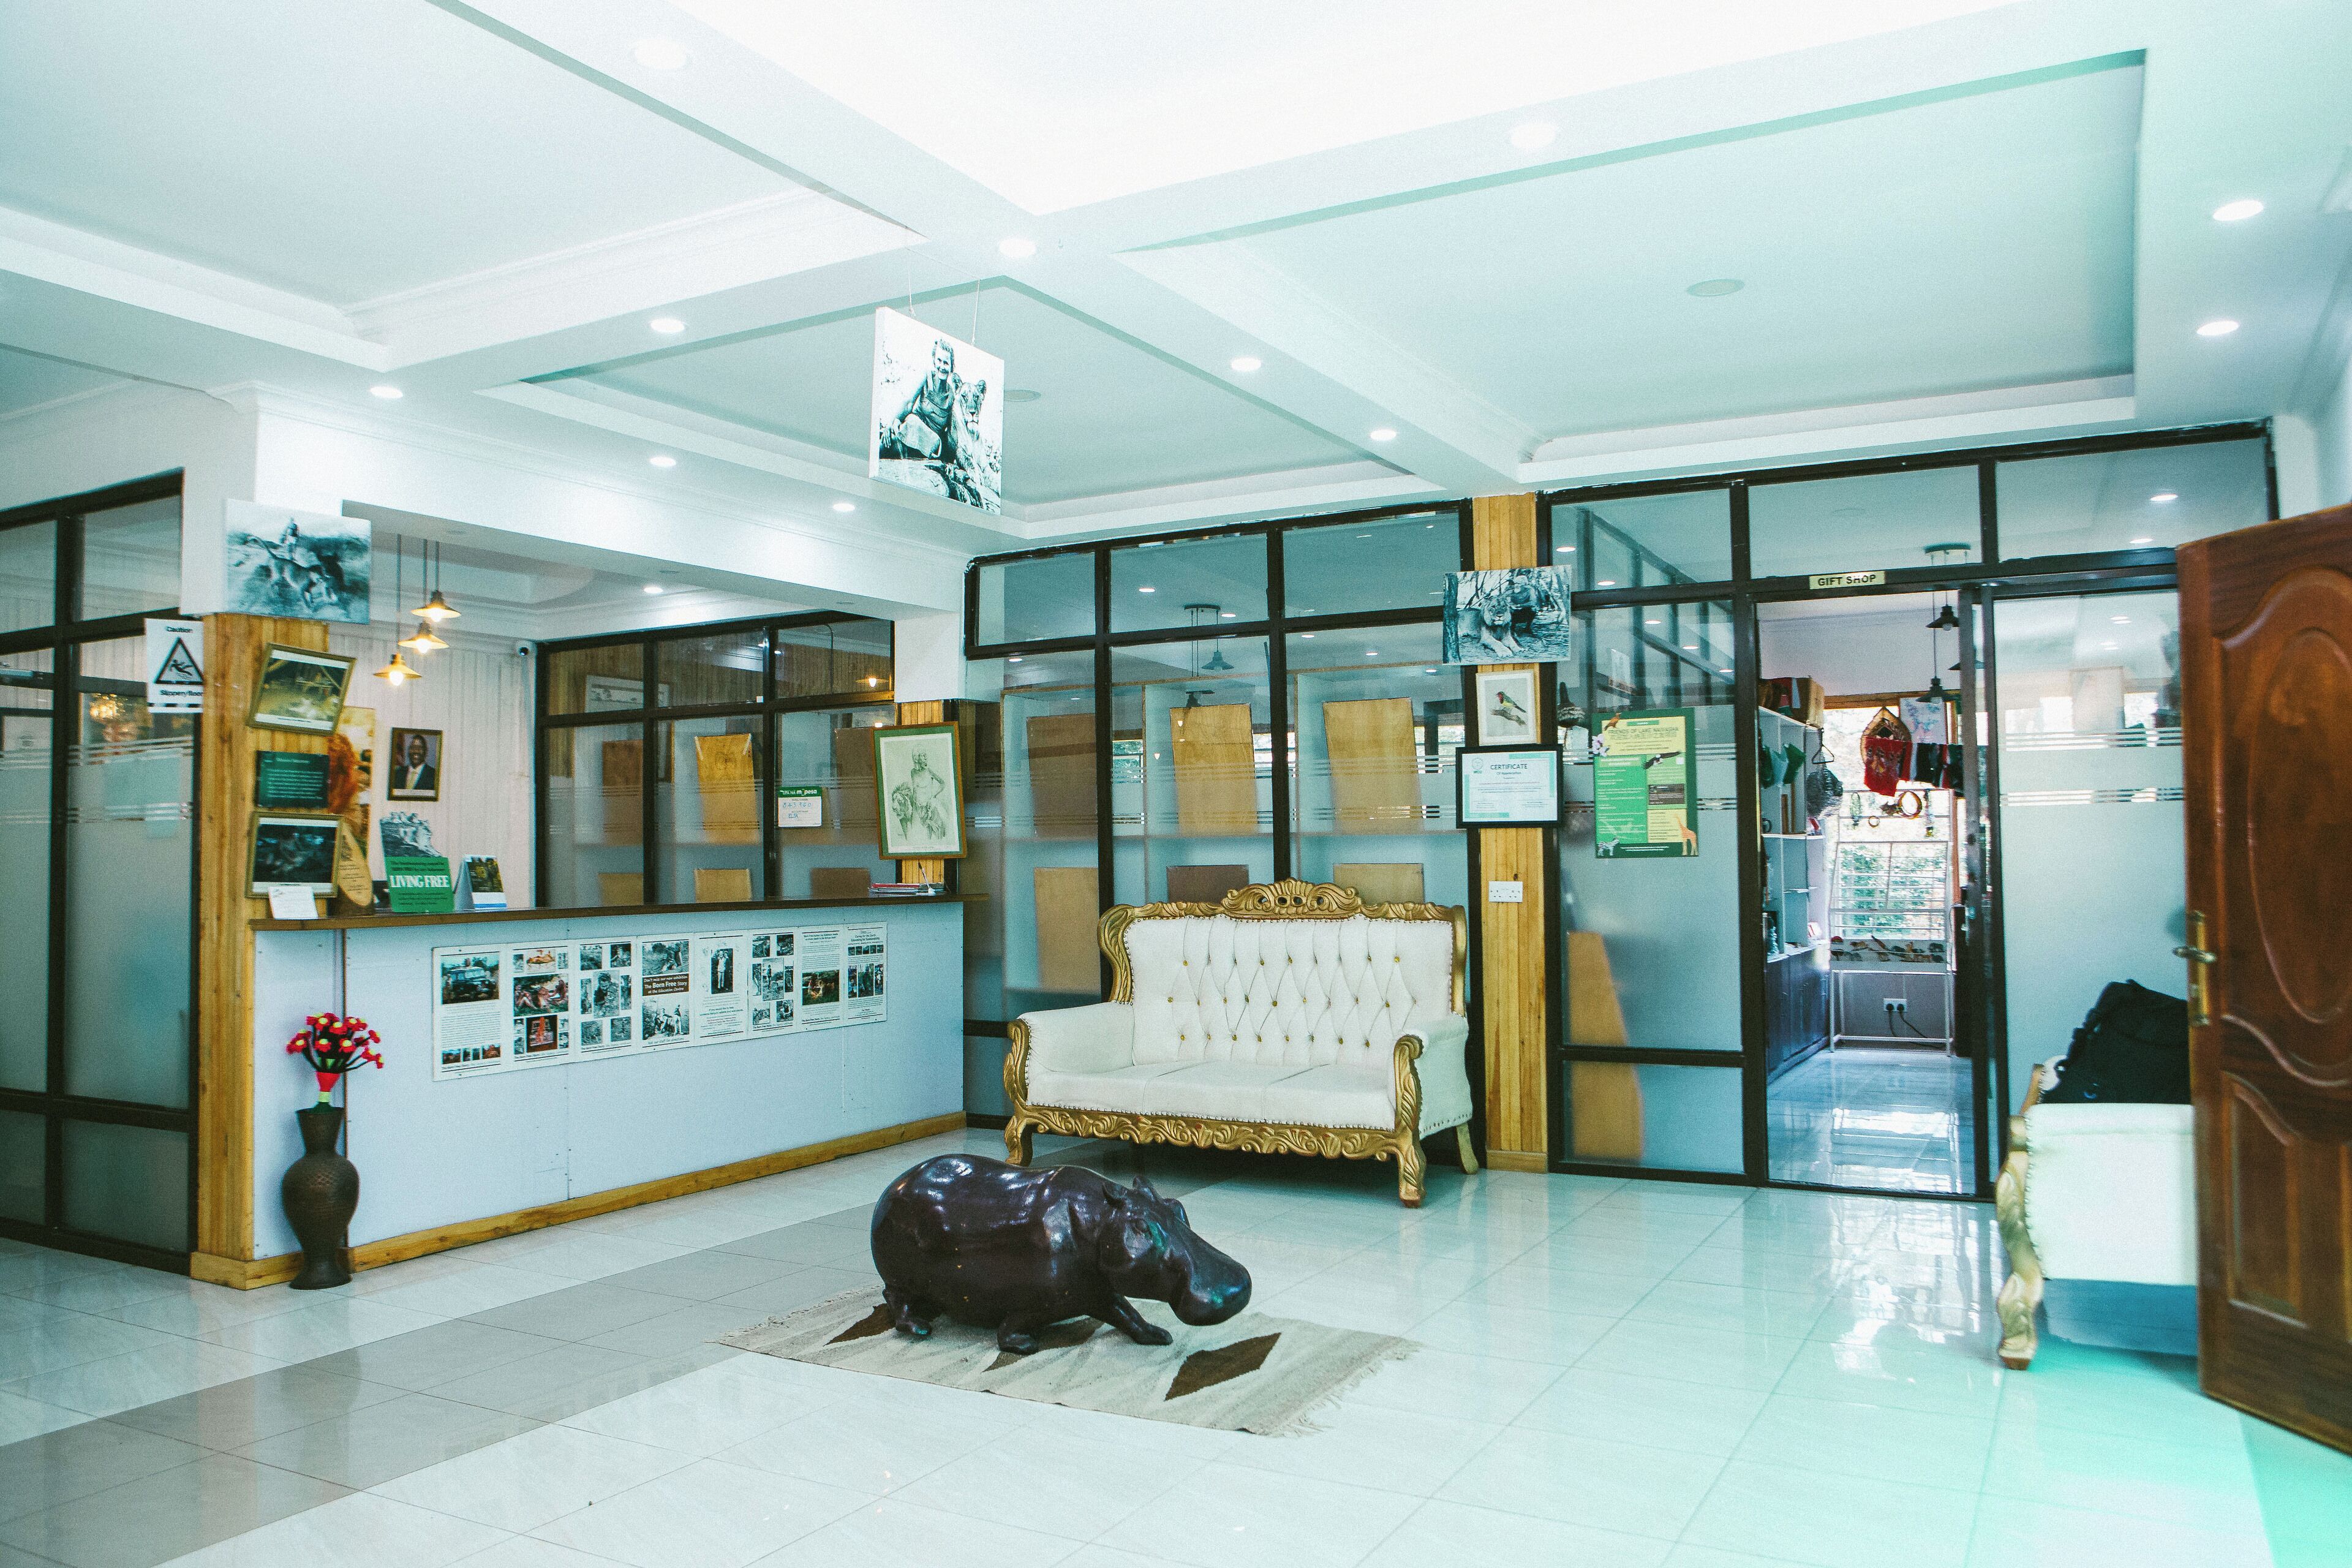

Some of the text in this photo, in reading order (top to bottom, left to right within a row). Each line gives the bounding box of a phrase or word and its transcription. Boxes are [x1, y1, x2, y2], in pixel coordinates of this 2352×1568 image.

[1818, 574, 1876, 586] GIFT SHOP
[389, 875, 450, 888] LIVING FREE
